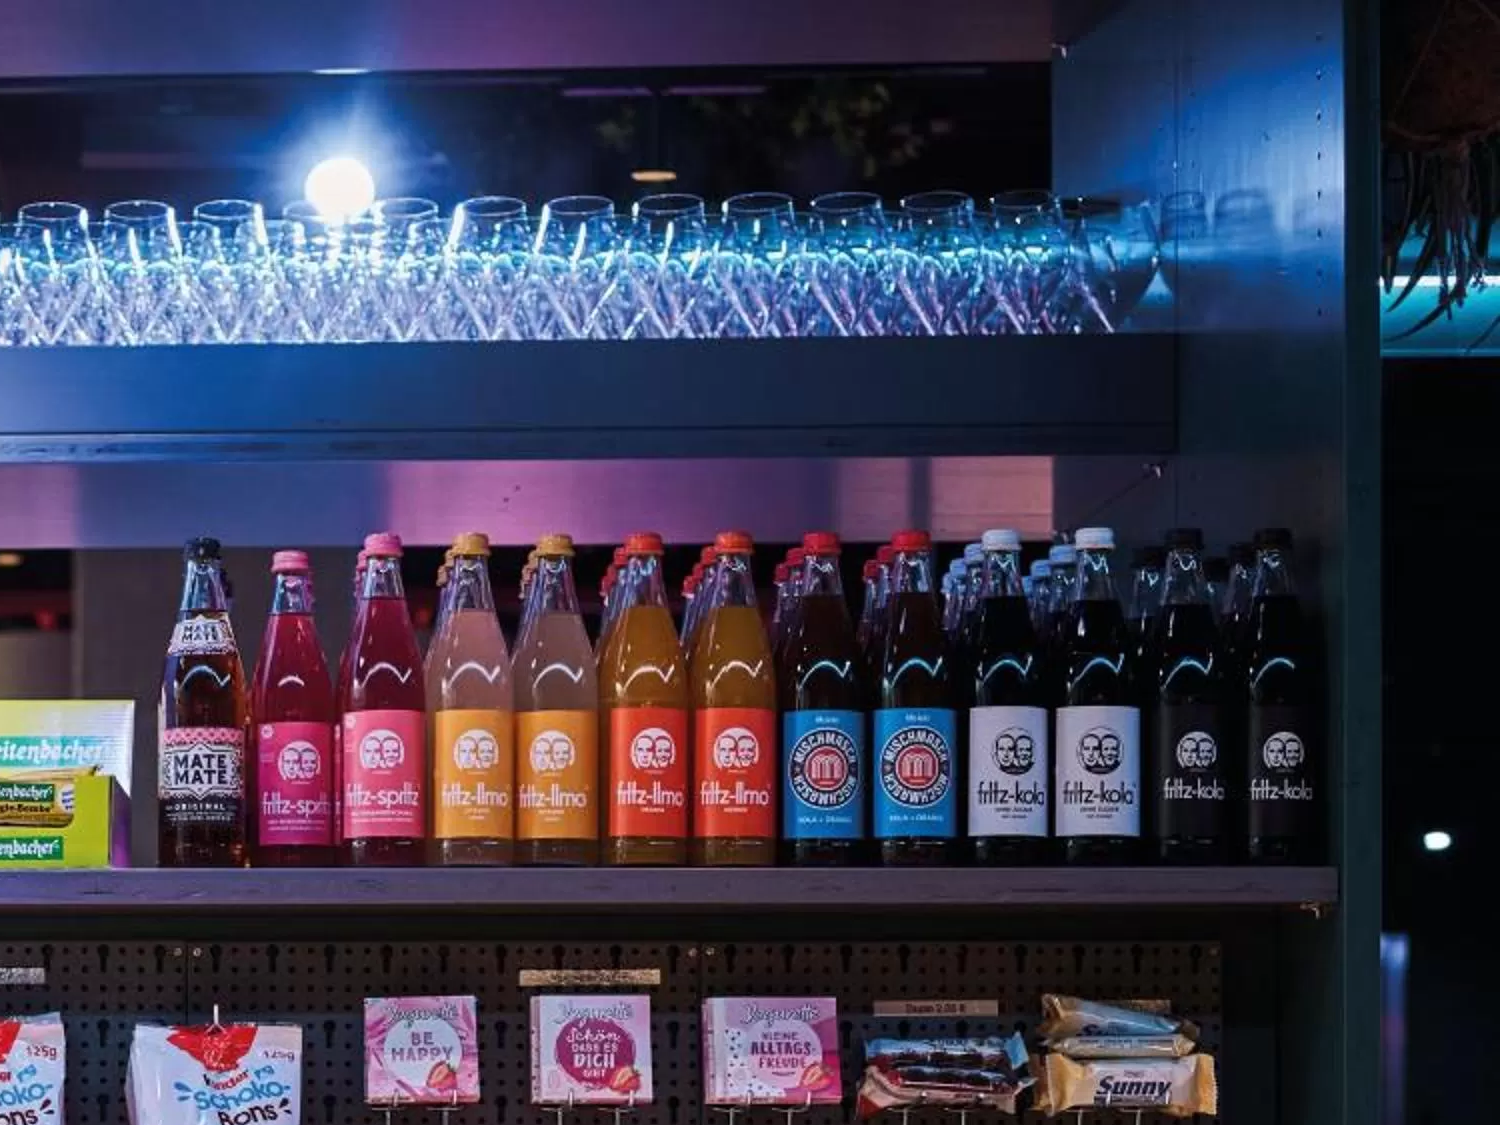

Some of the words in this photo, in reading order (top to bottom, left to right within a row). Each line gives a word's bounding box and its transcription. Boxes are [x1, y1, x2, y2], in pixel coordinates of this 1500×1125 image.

[173, 754, 227, 769] MATE
[174, 769, 228, 785] MATE
[978, 781, 1044, 806] fritz-kola
[1063, 781, 1134, 805] fritz-kola
[1250, 778, 1313, 801] fritz-kola
[411, 1031, 435, 1046] BE
[391, 1046, 453, 1061] HAPPY
[573, 1053, 615, 1069] DICH
[1096, 1075, 1172, 1100] Sunny
